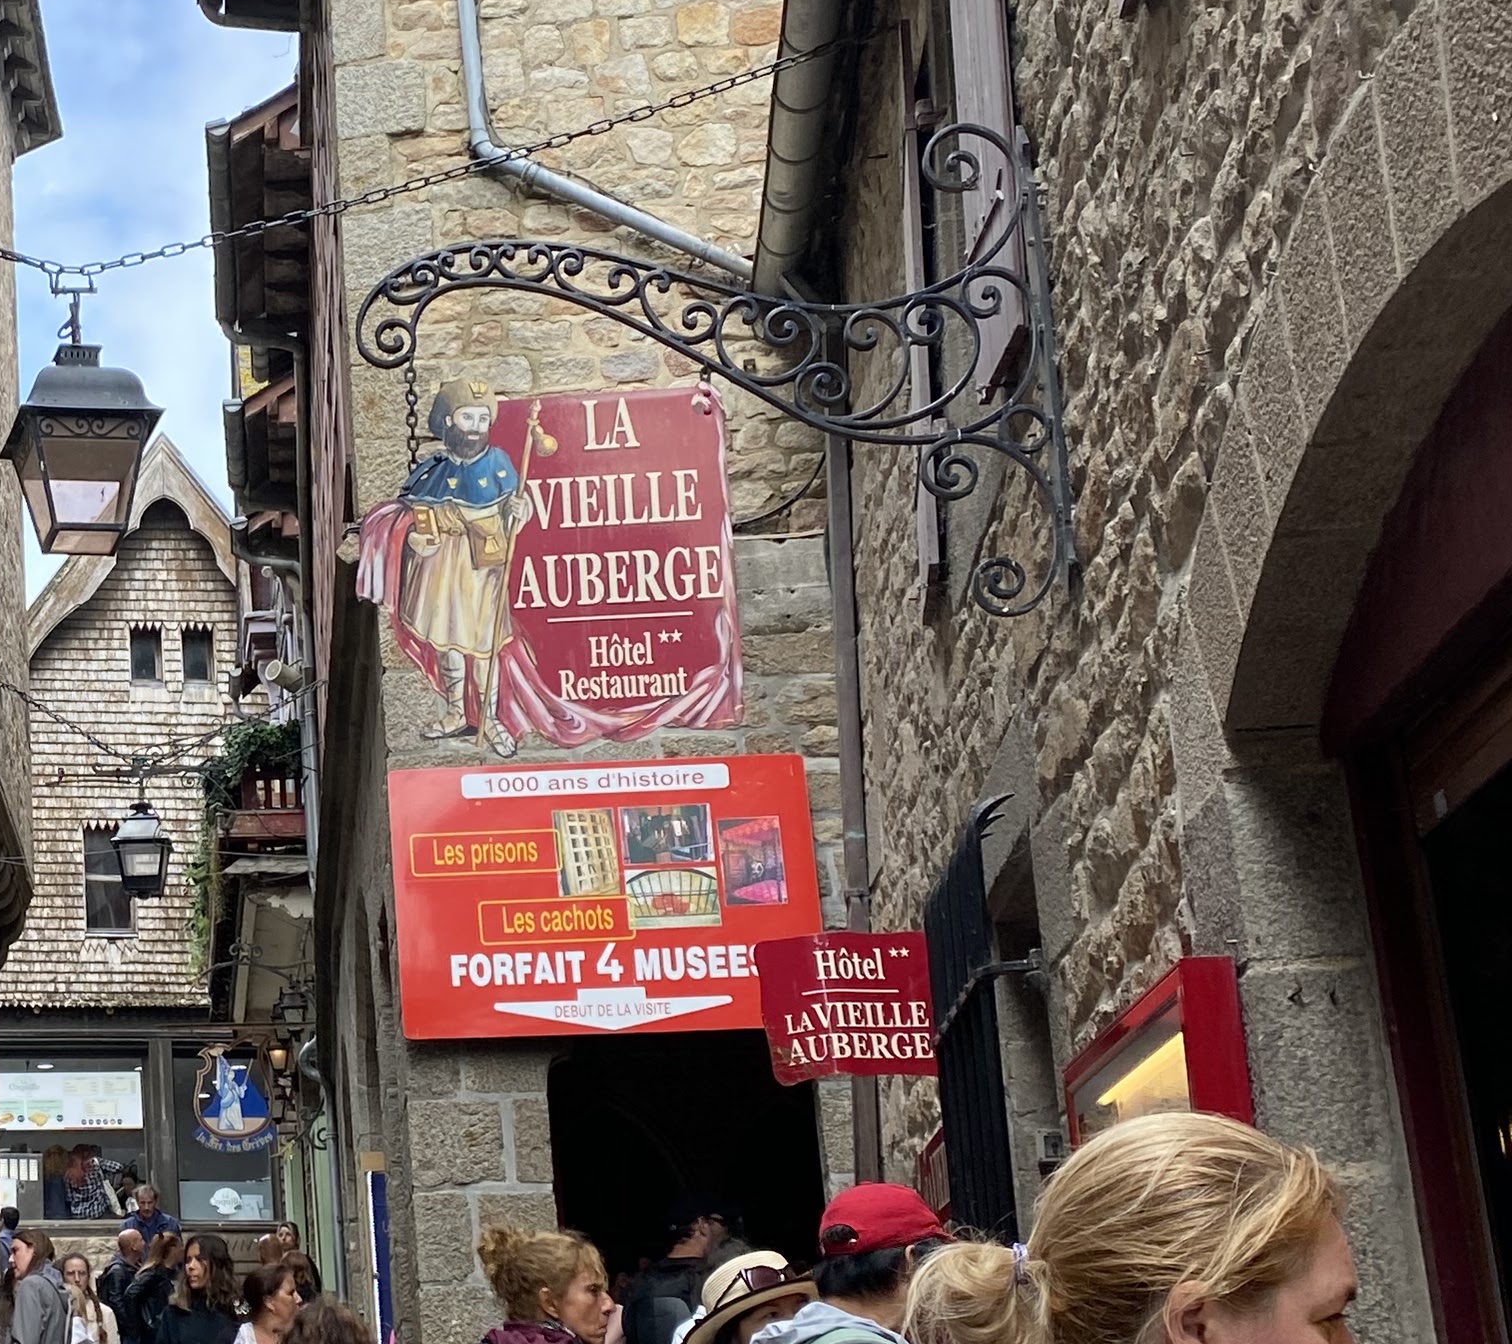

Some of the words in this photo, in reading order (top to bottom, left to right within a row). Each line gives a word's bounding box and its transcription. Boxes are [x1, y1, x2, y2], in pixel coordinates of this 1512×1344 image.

[582, 397, 640, 450] LA
[526, 469, 702, 530] VIEILLE
[514, 546, 724, 609] AUBERGE
[589, 631, 654, 668] Hôtel
[558, 666, 688, 701] Restaurant
[485, 776, 539, 793] 1000
[548, 776, 588, 791] ans
[598, 770, 705, 789] d'histoire
[433, 839, 465, 865] Les
[471, 837, 538, 871] prisons
[502, 906, 535, 933] Les
[540, 904, 614, 932] cachots
[450, 950, 585, 987] FORFAIT
[596, 942, 624, 982] 4
[813, 947, 886, 980] Hôtel
[555, 1005, 593, 1018] DEBUT
[598, 1004, 613, 1017] DE
[617, 1003, 632, 1016] LA
[635, 1002, 671, 1015] VISITE
[784, 1011, 815, 1035] LA
[811, 1001, 930, 1029] VIEILLE
[788, 1032, 934, 1067] AUBERGE
